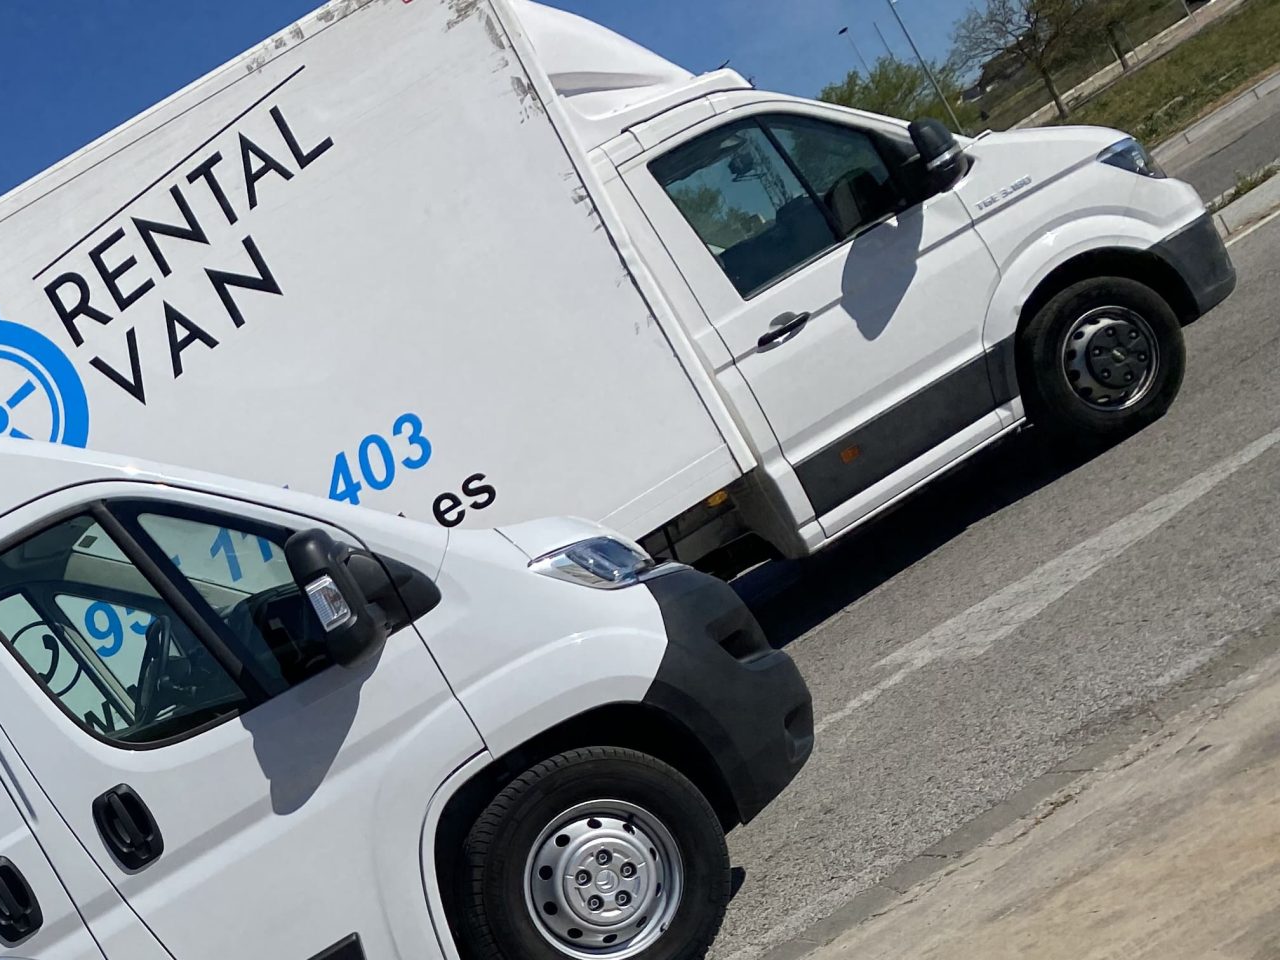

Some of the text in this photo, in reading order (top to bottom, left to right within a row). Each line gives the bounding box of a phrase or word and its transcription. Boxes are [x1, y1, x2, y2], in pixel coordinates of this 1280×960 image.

[43, 105, 335, 348] RENTAL
[88, 235, 284, 406] VAN
[328, 412, 433, 506] 403
